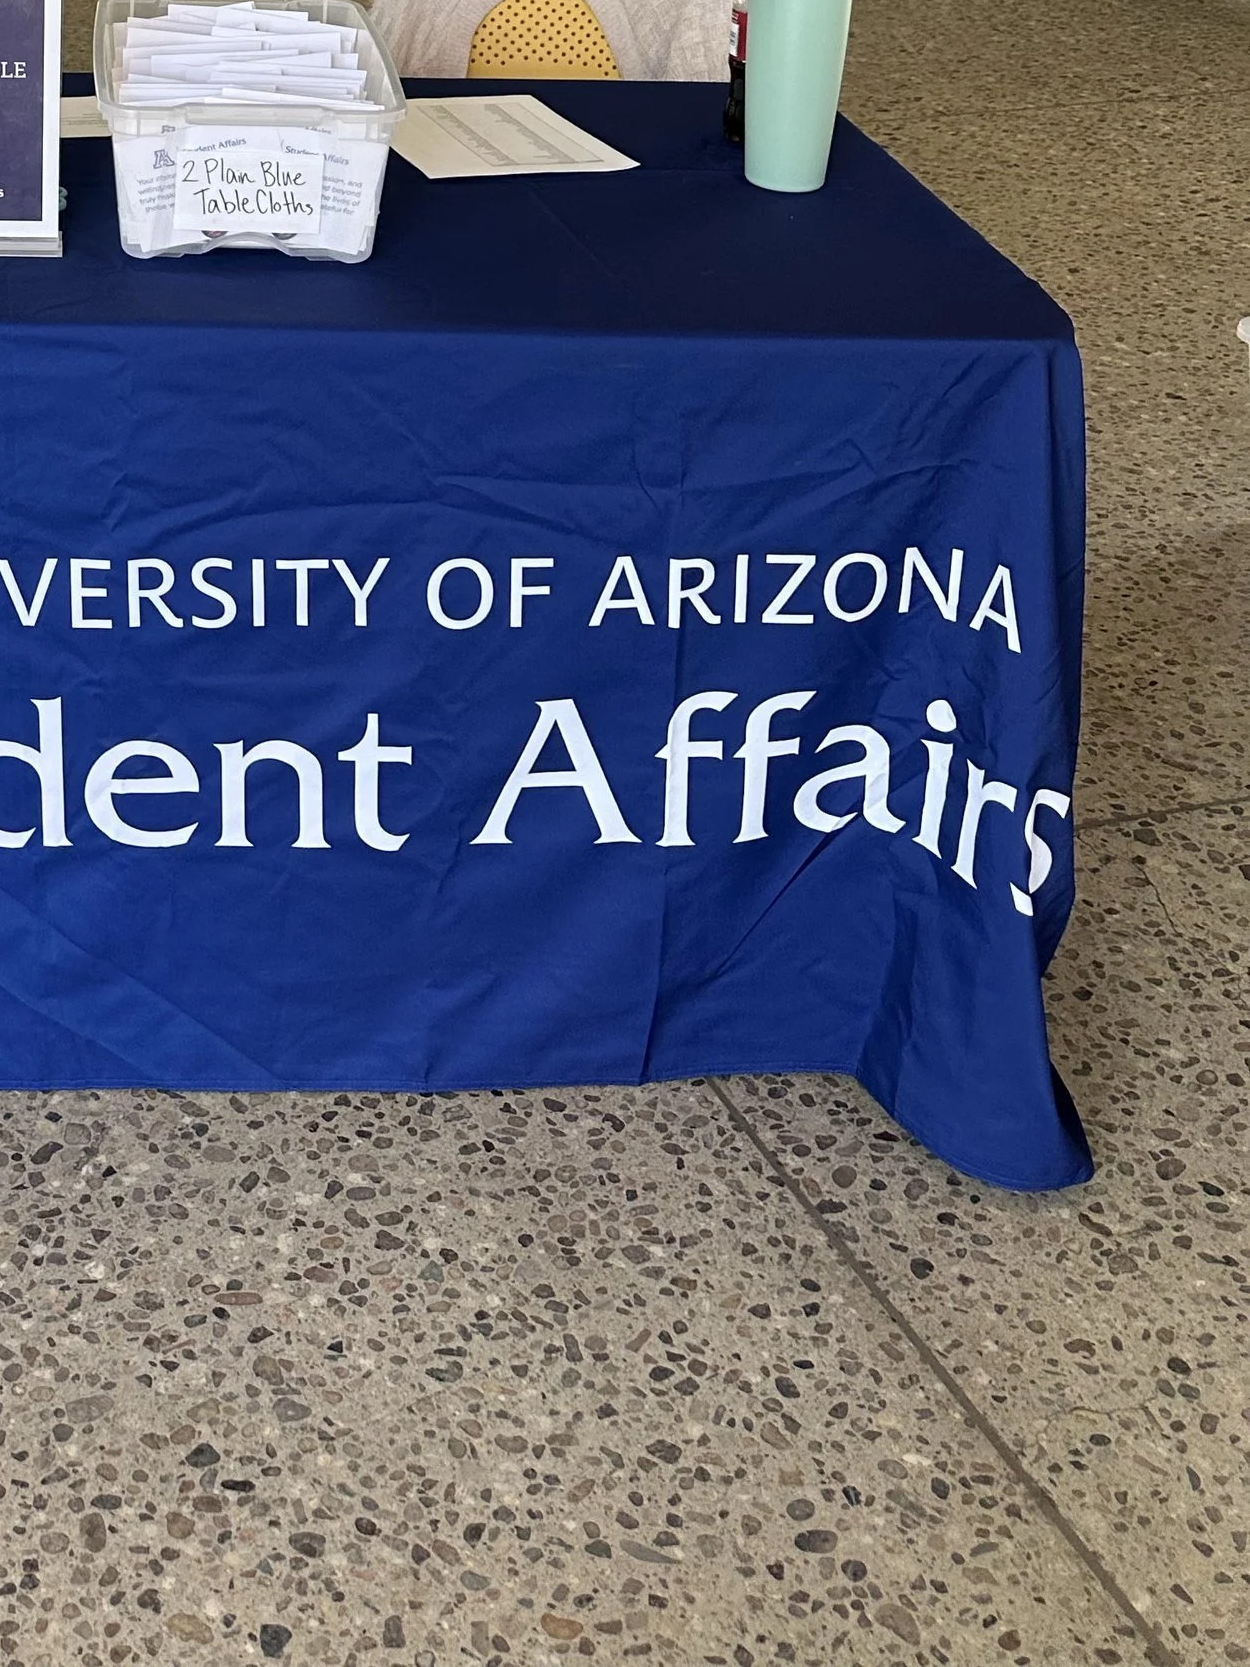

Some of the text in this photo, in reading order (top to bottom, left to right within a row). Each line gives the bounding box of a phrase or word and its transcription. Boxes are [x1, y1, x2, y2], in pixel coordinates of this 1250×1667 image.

[181, 160, 199, 183] 2
[260, 160, 307, 187] Blue
[218, 138, 247, 149] Affairs
[426, 556, 555, 630] OF
[588, 546, 1022, 654] ARIZONA
[468, 690, 1071, 917] Affairs
